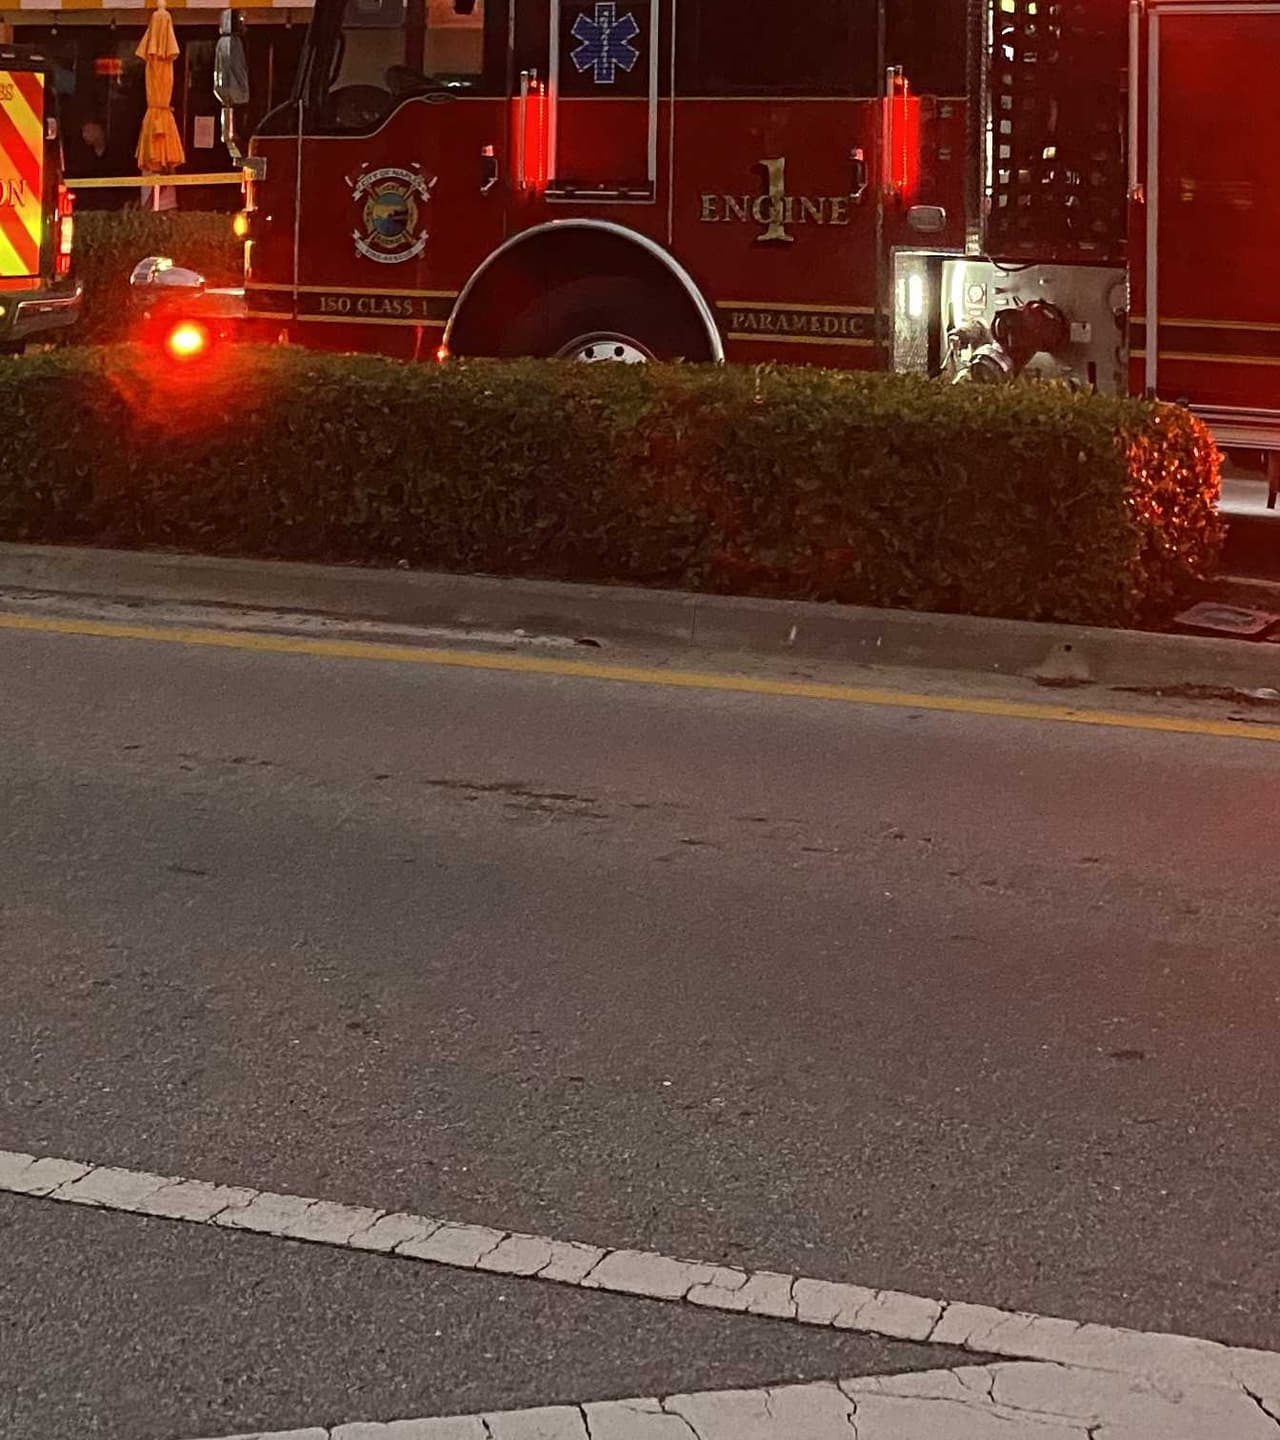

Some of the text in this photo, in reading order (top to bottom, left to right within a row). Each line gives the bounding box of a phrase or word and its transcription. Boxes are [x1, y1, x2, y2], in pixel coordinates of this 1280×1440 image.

[699, 194, 850, 225] ENGINE
[756, 157, 794, 242] 1
[319, 296, 351, 313] ISO
[358, 298, 413, 316] CLASS
[731, 312, 865, 334] PARAMEDIC
